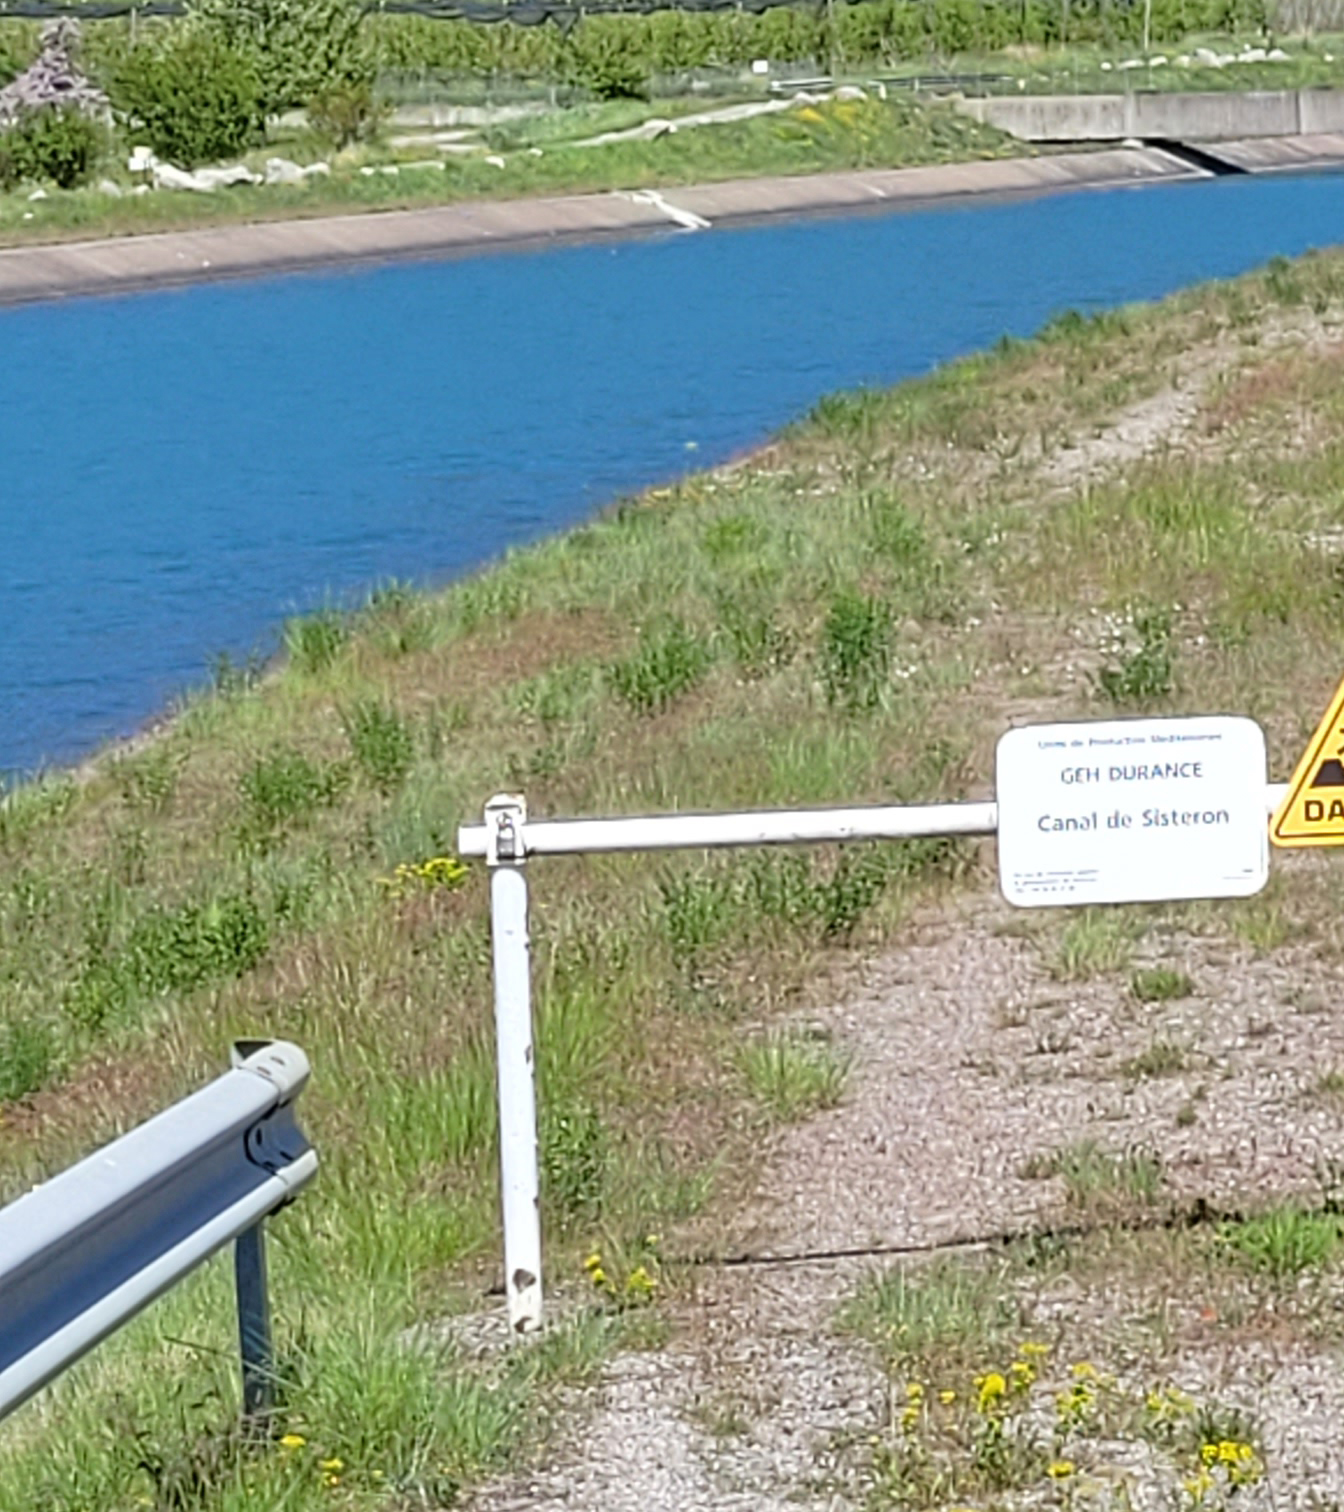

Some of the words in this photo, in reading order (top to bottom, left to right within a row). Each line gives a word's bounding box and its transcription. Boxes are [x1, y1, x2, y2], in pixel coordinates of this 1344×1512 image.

[1060, 766, 1100, 785] GEH
[1109, 761, 1204, 782] DURANCE
[1037, 811, 1098, 833] Canal
[1106, 809, 1133, 830] de
[1141, 808, 1230, 829] Sisteron
